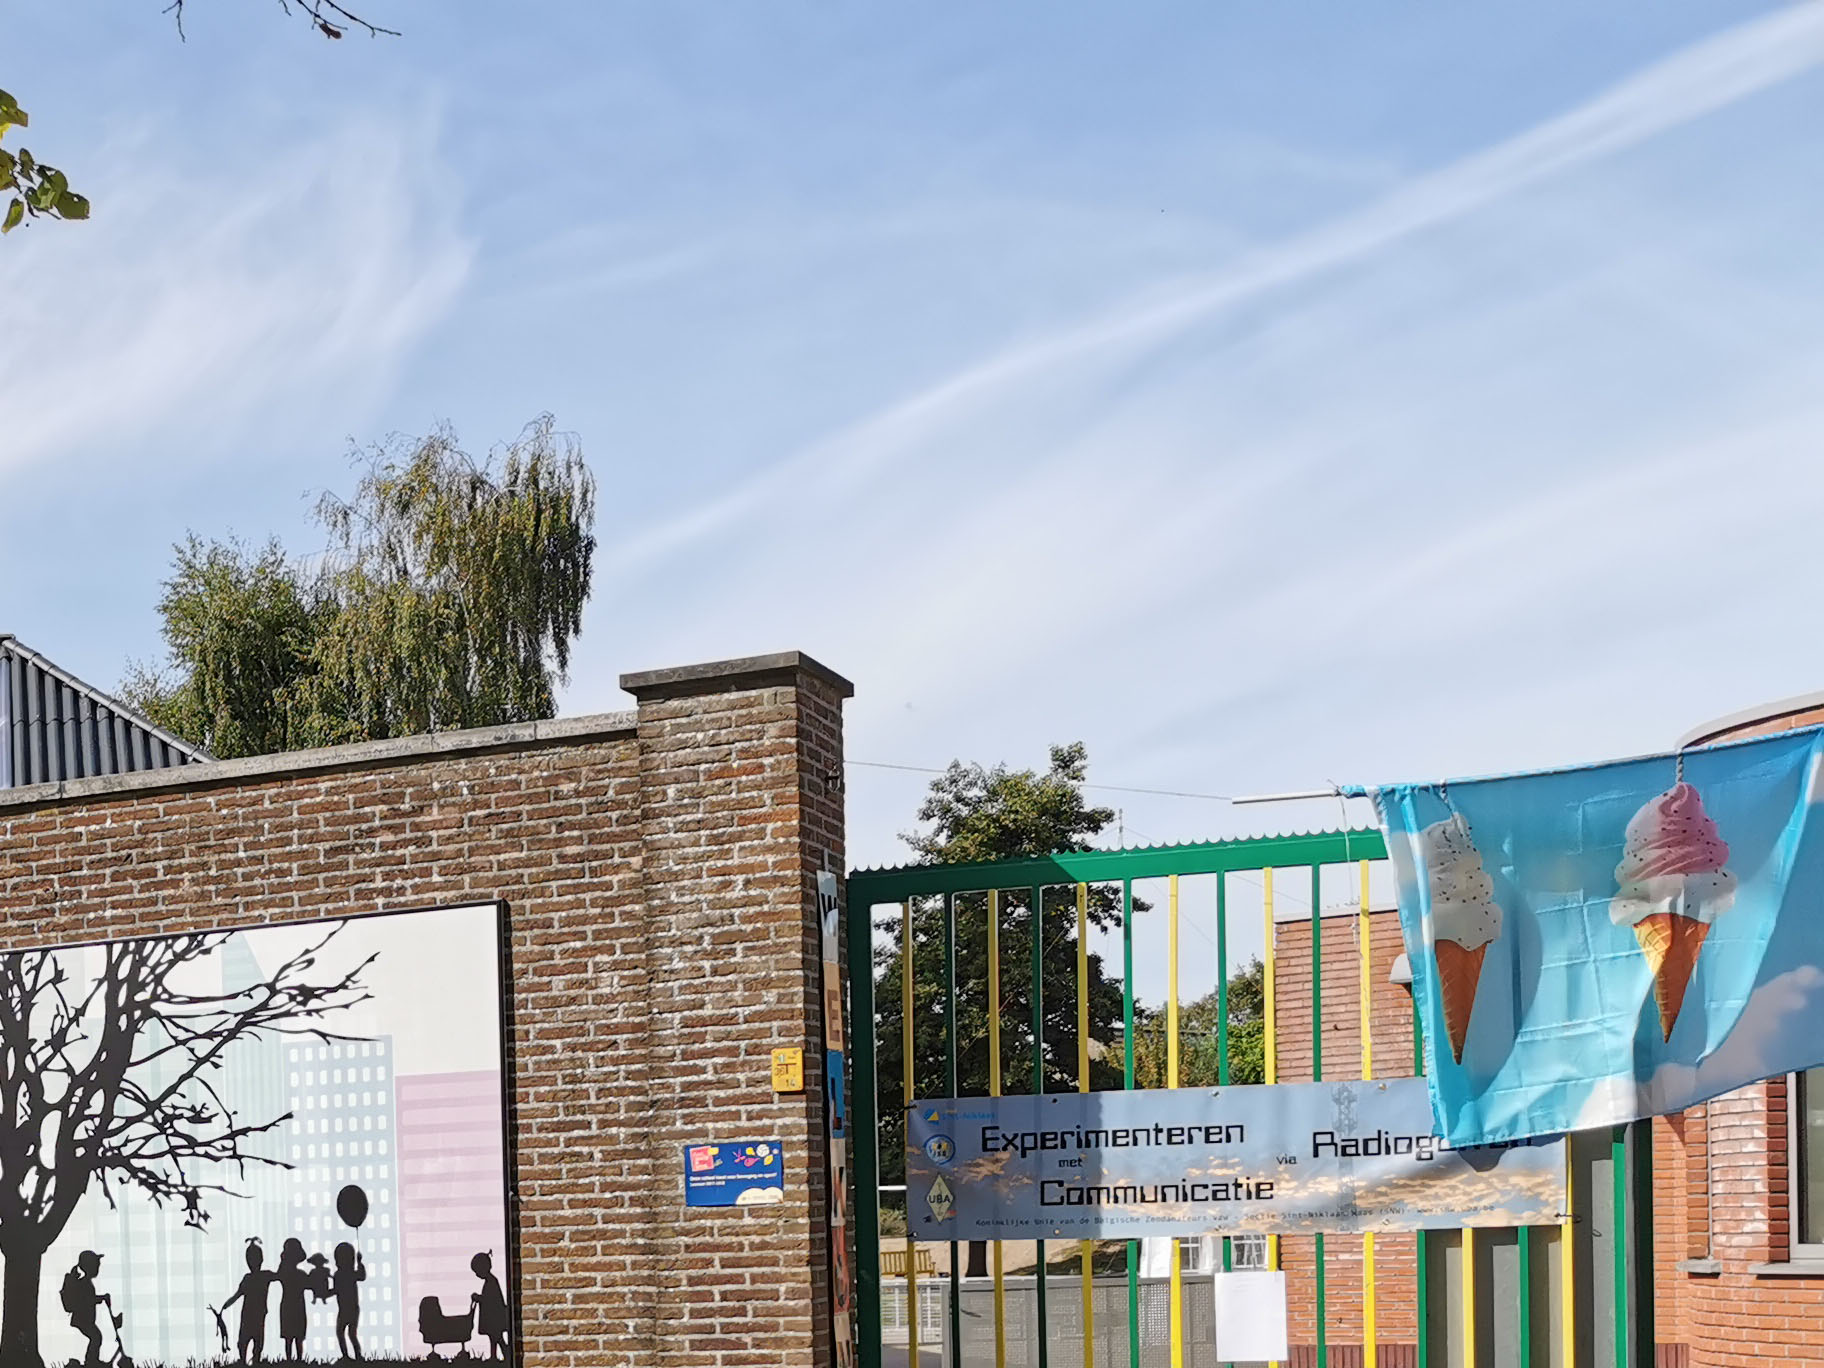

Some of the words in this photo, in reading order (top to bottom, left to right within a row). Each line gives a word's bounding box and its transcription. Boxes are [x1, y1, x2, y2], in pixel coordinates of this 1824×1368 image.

[981, 1122, 1245, 1159] Experimenteren
[1058, 1157, 1083, 1168] met
[1276, 1153, 1297, 1165] via
[1040, 1176, 1274, 1206] Communicatie
[928, 1193, 952, 1204] UBA
